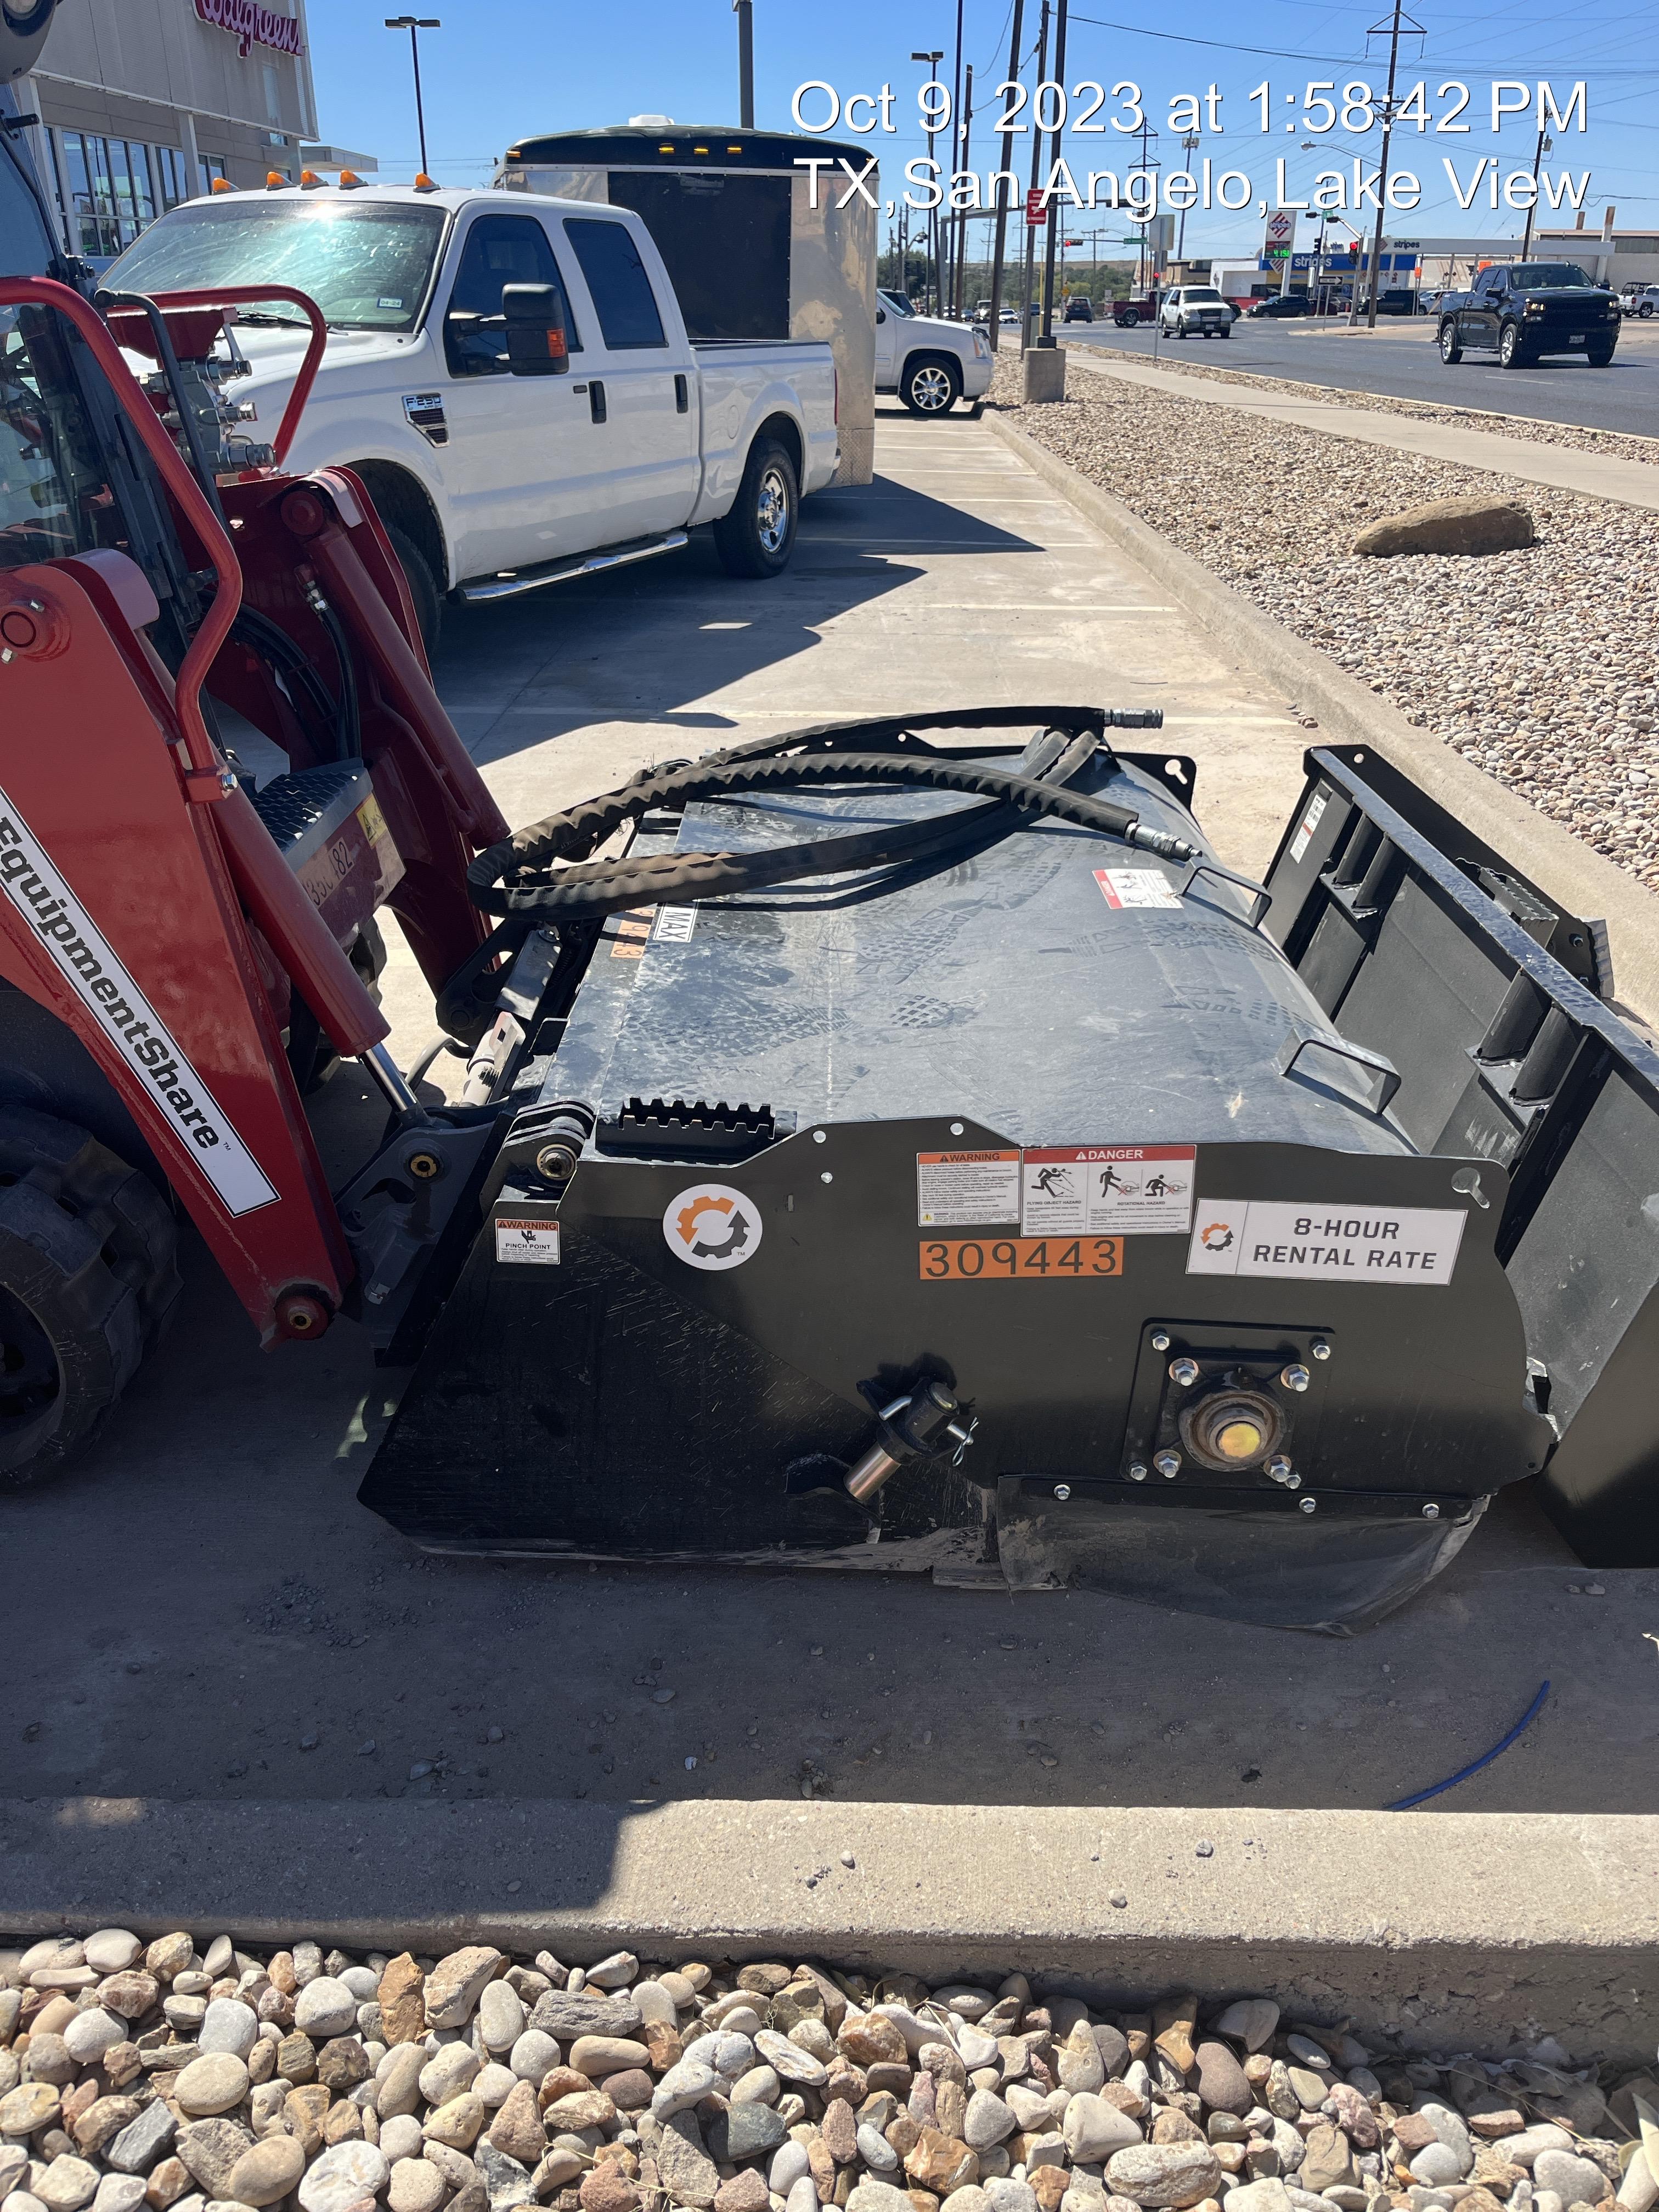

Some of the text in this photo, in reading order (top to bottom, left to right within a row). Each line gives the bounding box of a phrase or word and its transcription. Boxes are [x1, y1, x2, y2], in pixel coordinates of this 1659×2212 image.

[1393, 240, 1420, 250] stripes
[406, 396, 441, 407] F-250
[658, 911, 691, 940] MAX
[950, 1153, 1000, 1162] WARNING
[1088, 1149, 1143, 1160] DANGER
[506, 1221, 556, 1230] WARNING
[1294, 1217, 1400, 1240] 8-HOUR
[926, 1240, 1116, 1277] 309443
[1253, 1244, 1437, 1270] RENTAL RATE
